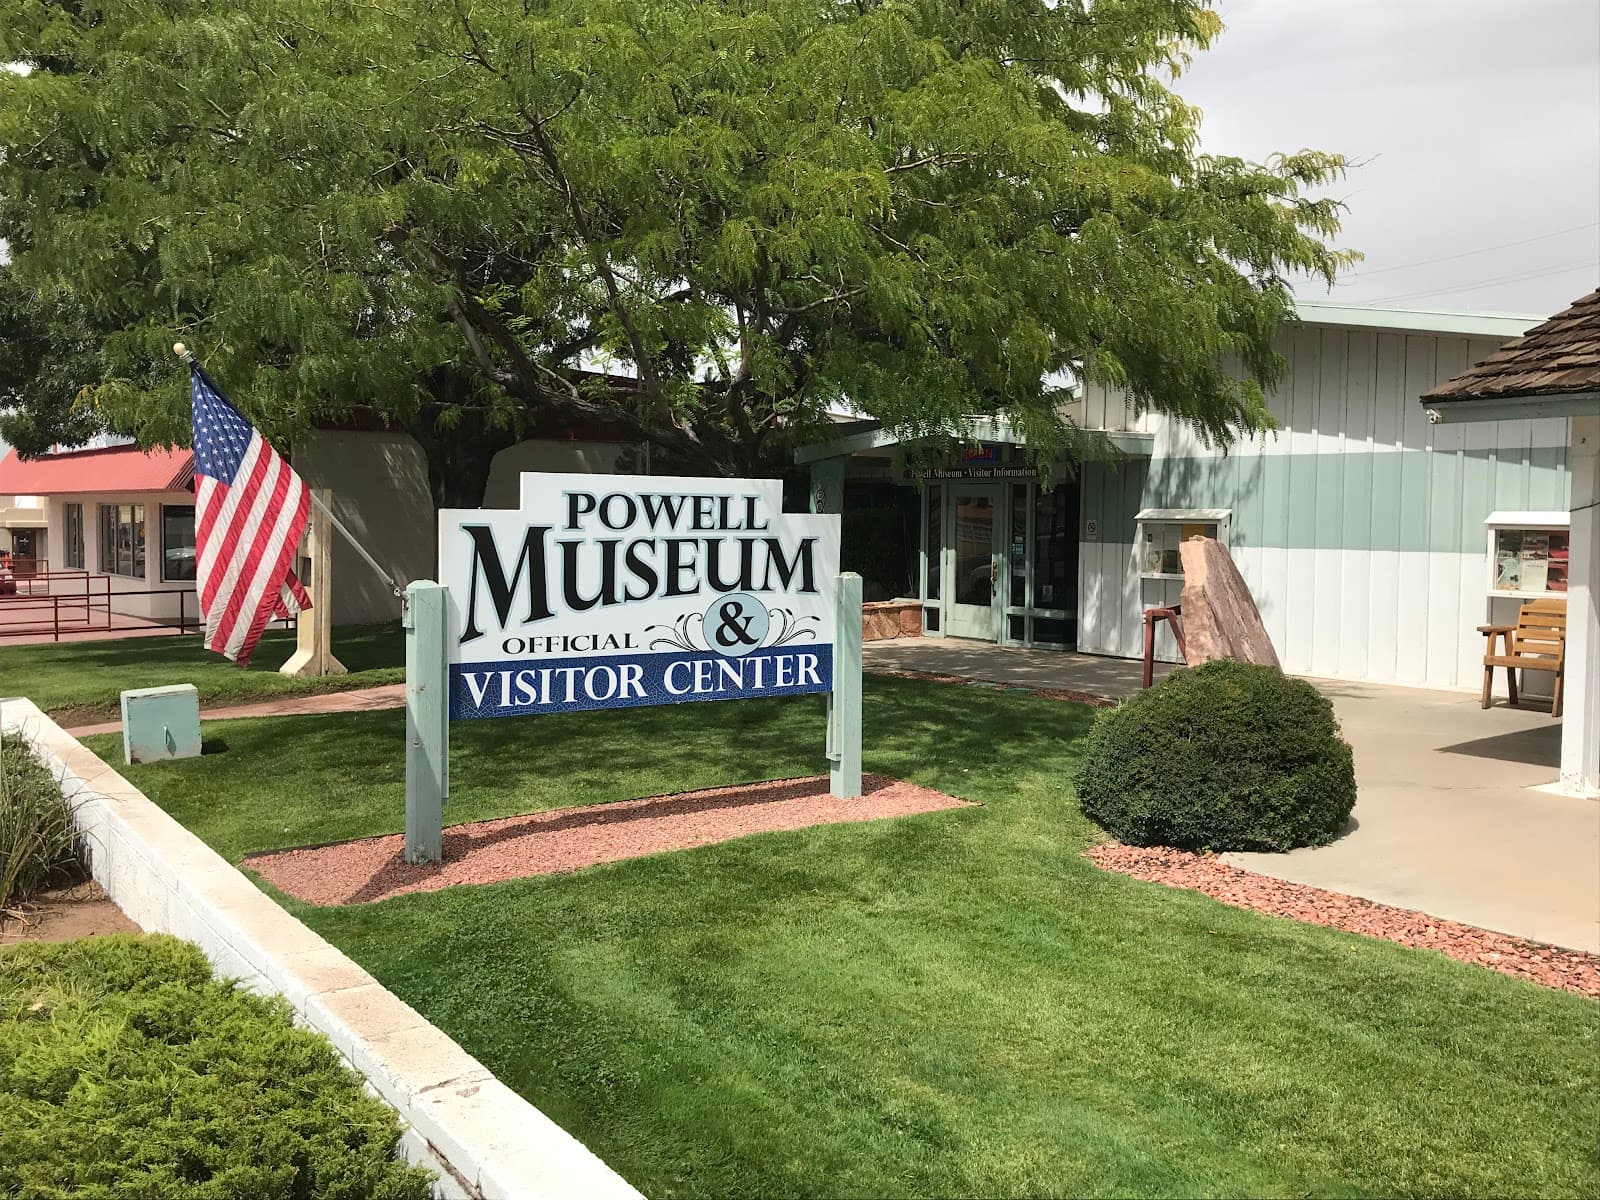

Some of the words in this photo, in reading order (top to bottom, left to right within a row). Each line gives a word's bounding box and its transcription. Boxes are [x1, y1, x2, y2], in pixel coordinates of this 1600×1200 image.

[934, 468, 963, 479] Museum
[967, 467, 993, 478] Visitor
[993, 467, 1037, 478] Information
[566, 493, 768, 530] POWELL
[459, 523, 821, 646] MUSEUM
[502, 633, 639, 655] OFFICIAL
[715, 601, 759, 647] &
[460, 663, 648, 709] VISITOR
[663, 653, 823, 695] CENTER
